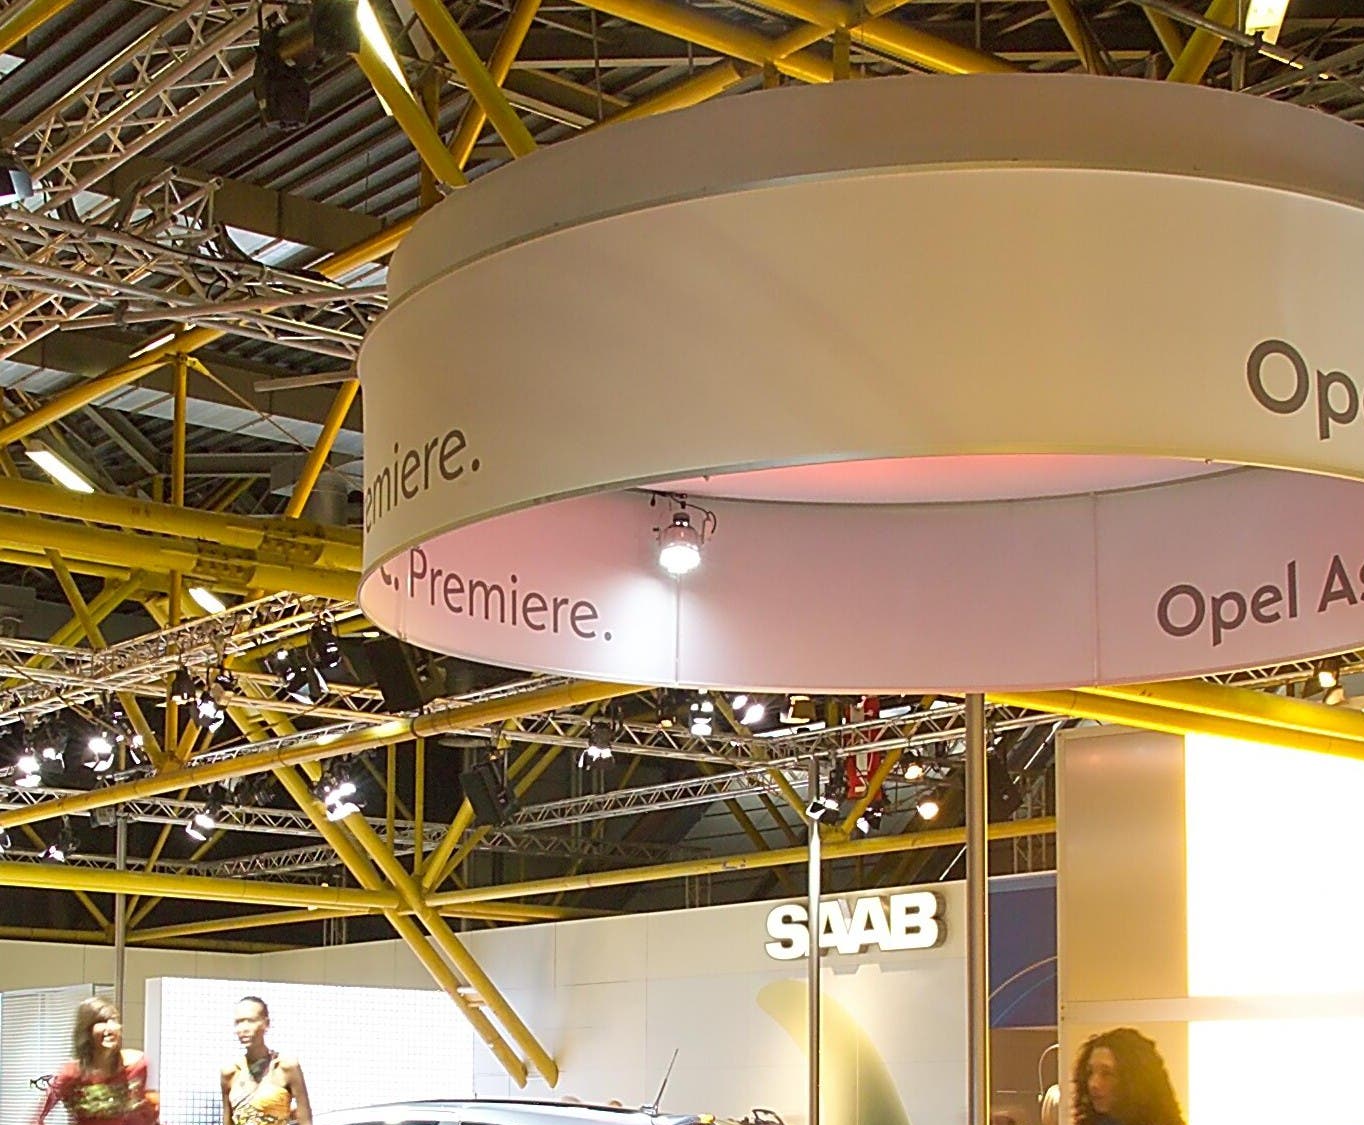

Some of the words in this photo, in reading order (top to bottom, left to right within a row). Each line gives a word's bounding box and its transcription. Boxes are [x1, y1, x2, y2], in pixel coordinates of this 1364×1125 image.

[409, 546, 613, 642] Premiere.
[1156, 560, 1299, 647] Opel
[764, 890, 942, 961] SAAB
